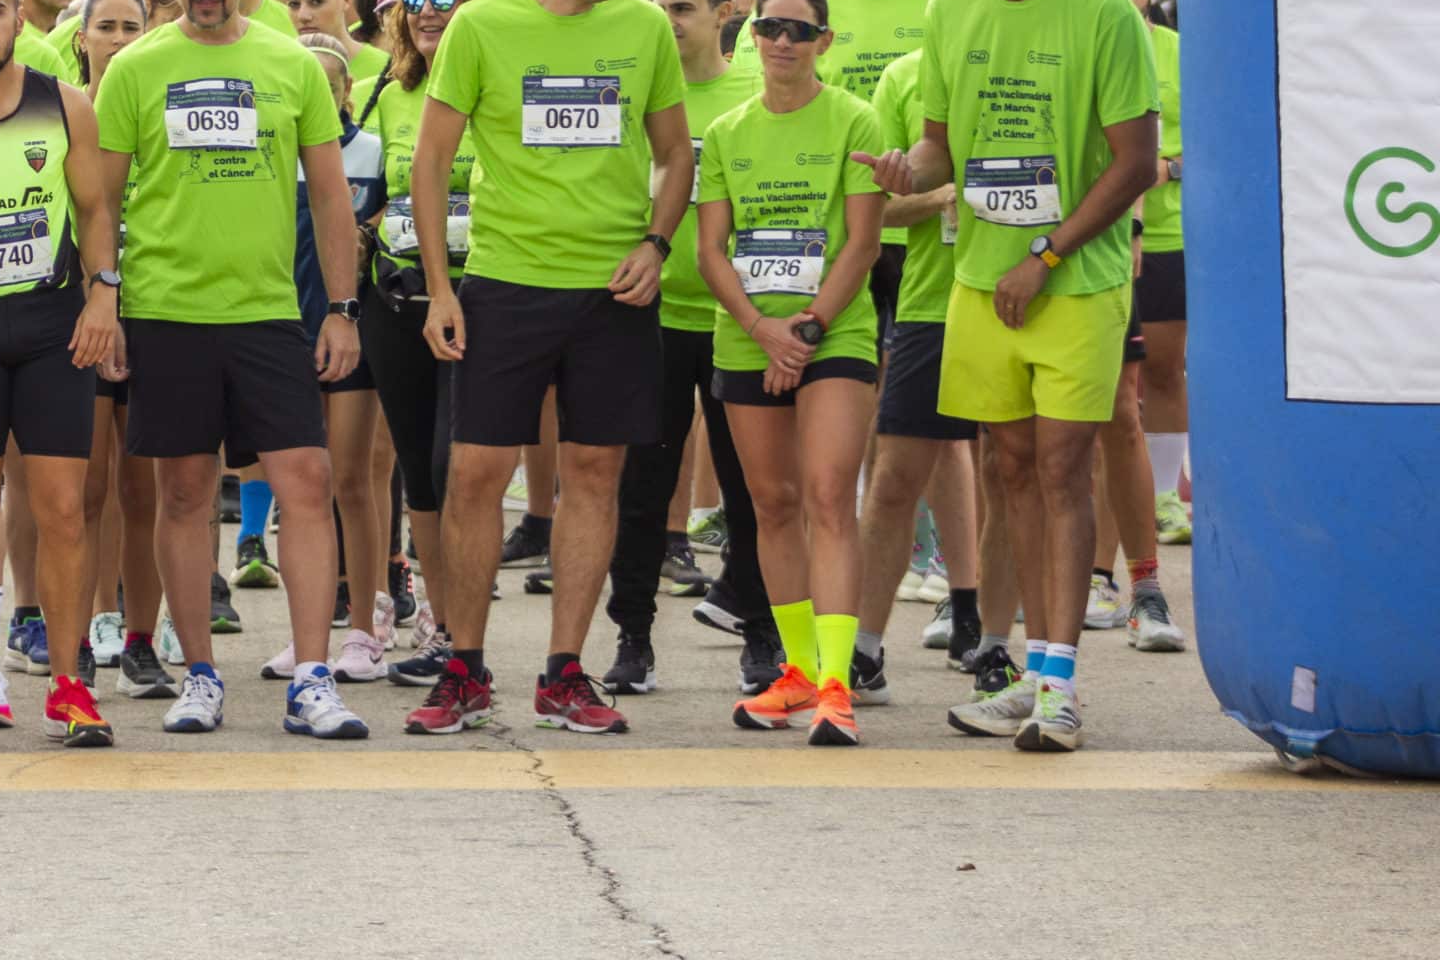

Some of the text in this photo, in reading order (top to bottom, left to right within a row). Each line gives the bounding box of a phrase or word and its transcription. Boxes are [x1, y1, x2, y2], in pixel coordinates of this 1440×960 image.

[187, 110, 240, 132] 0639
[545, 107, 600, 130] 0670
[213, 155, 246, 166] contra
[208, 167, 256, 179] el Cáncer
[757, 180, 810, 190] VIII Carrera
[740, 191, 827, 205] Rivas Vaciamadrid
[986, 188, 1038, 211] 0735
[759, 205, 809, 216] En Marcha
[768, 218, 799, 227] contra
[750, 258, 801, 277] 0736
